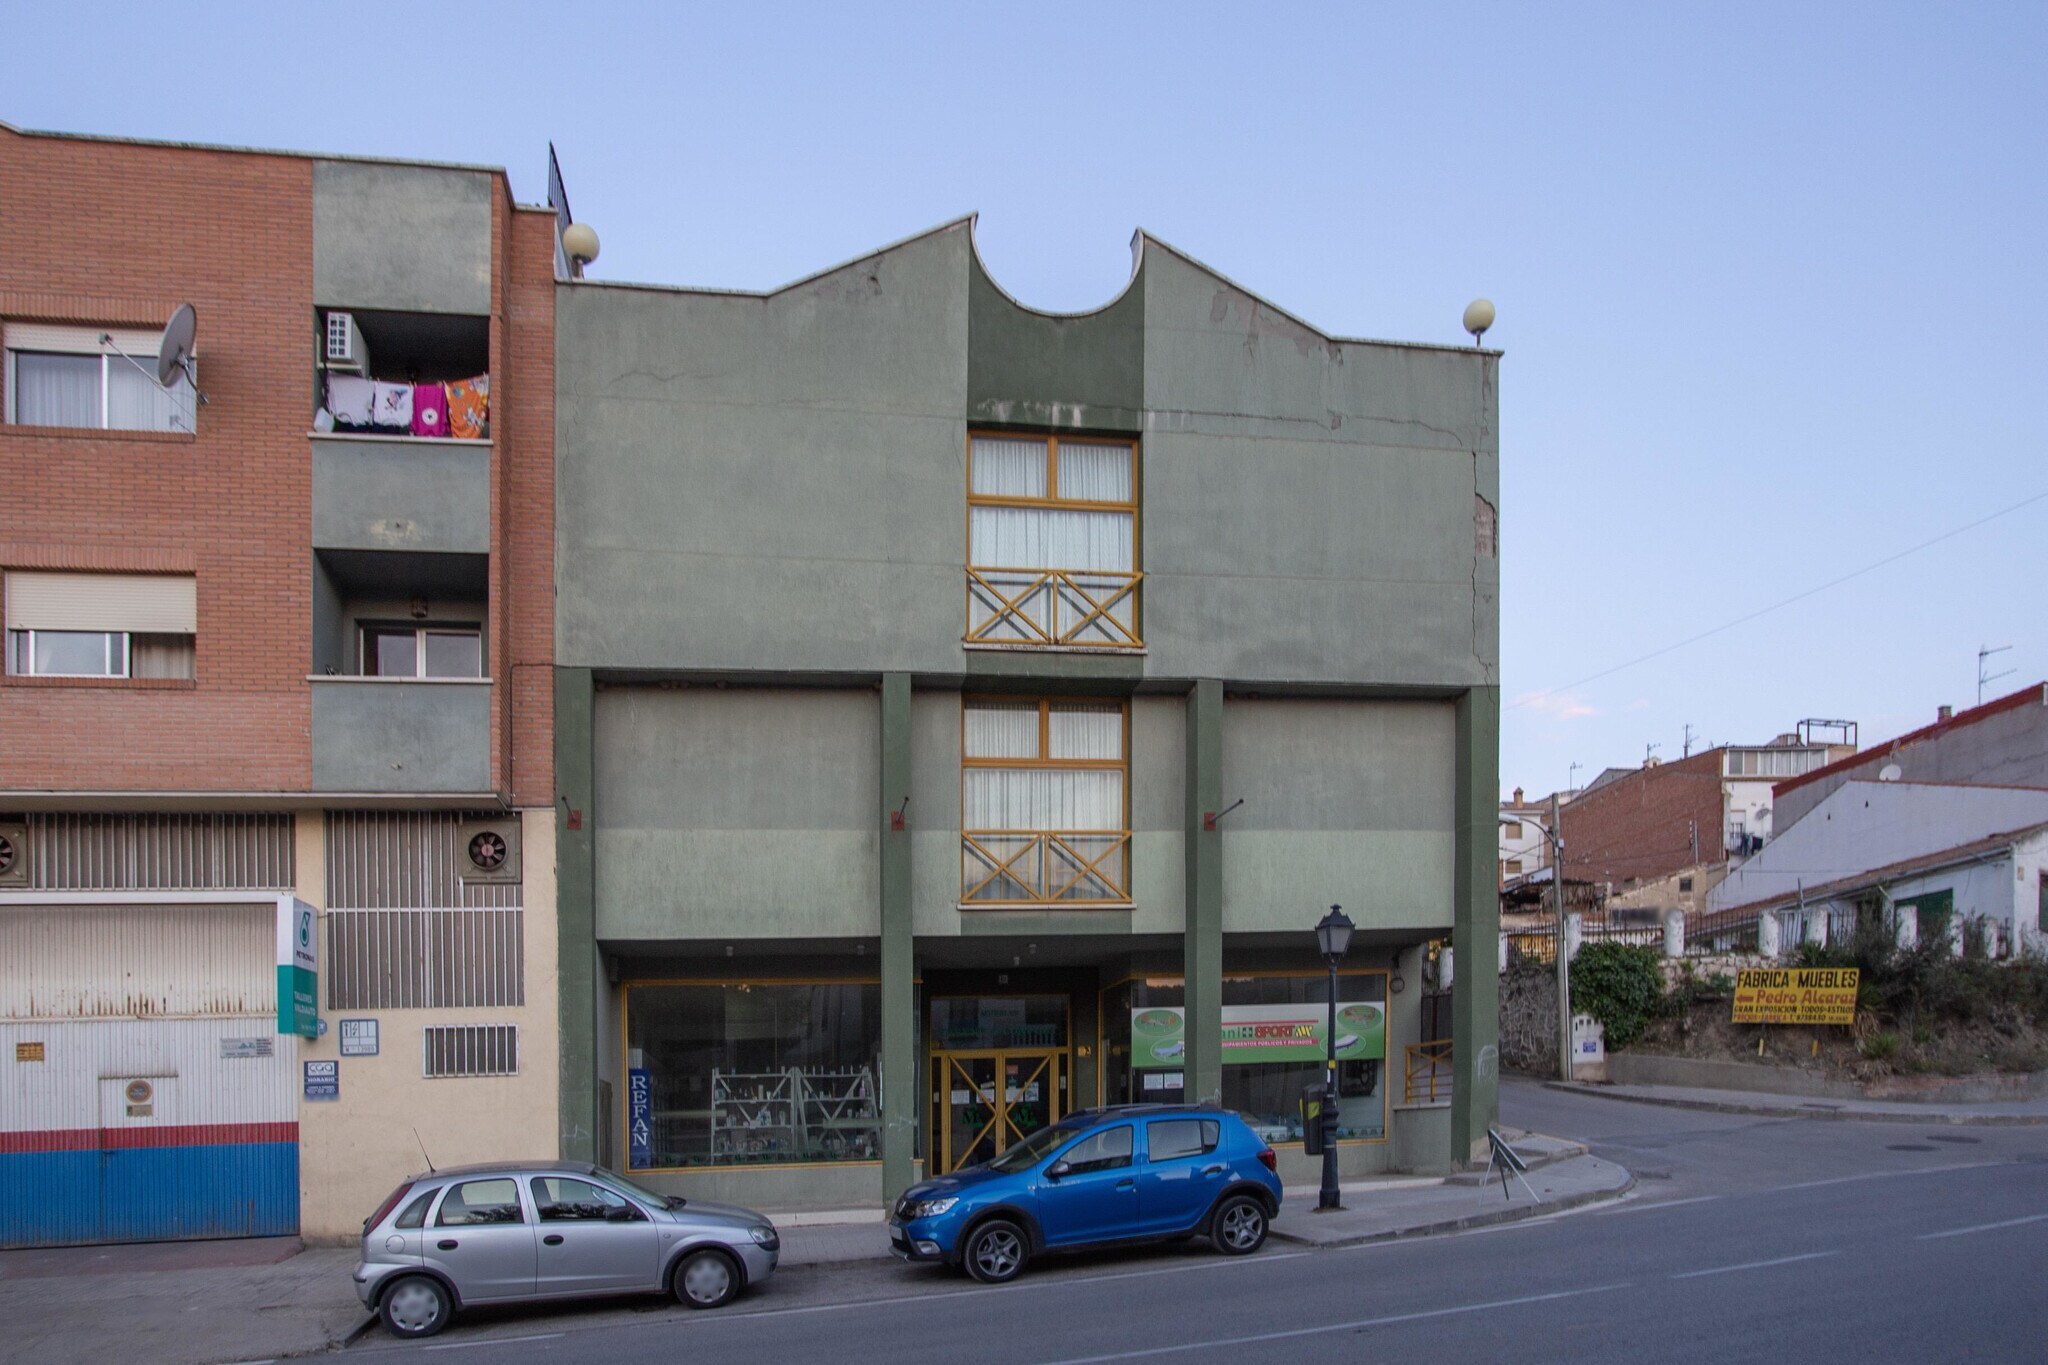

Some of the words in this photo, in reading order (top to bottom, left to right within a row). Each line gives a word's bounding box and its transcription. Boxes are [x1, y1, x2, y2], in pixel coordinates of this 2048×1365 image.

[1737, 971, 1790, 988] FABRICA
[1797, 971, 1857, 988] MUEBLES
[1756, 989, 1798, 1004] Pedro
[1801, 989, 1856, 1004] Alcaraz
[1734, 1005, 1753, 1013] GRAN
[1254, 1025, 1296, 1039] SPORT
[631, 1075, 649, 1147] REFAN
